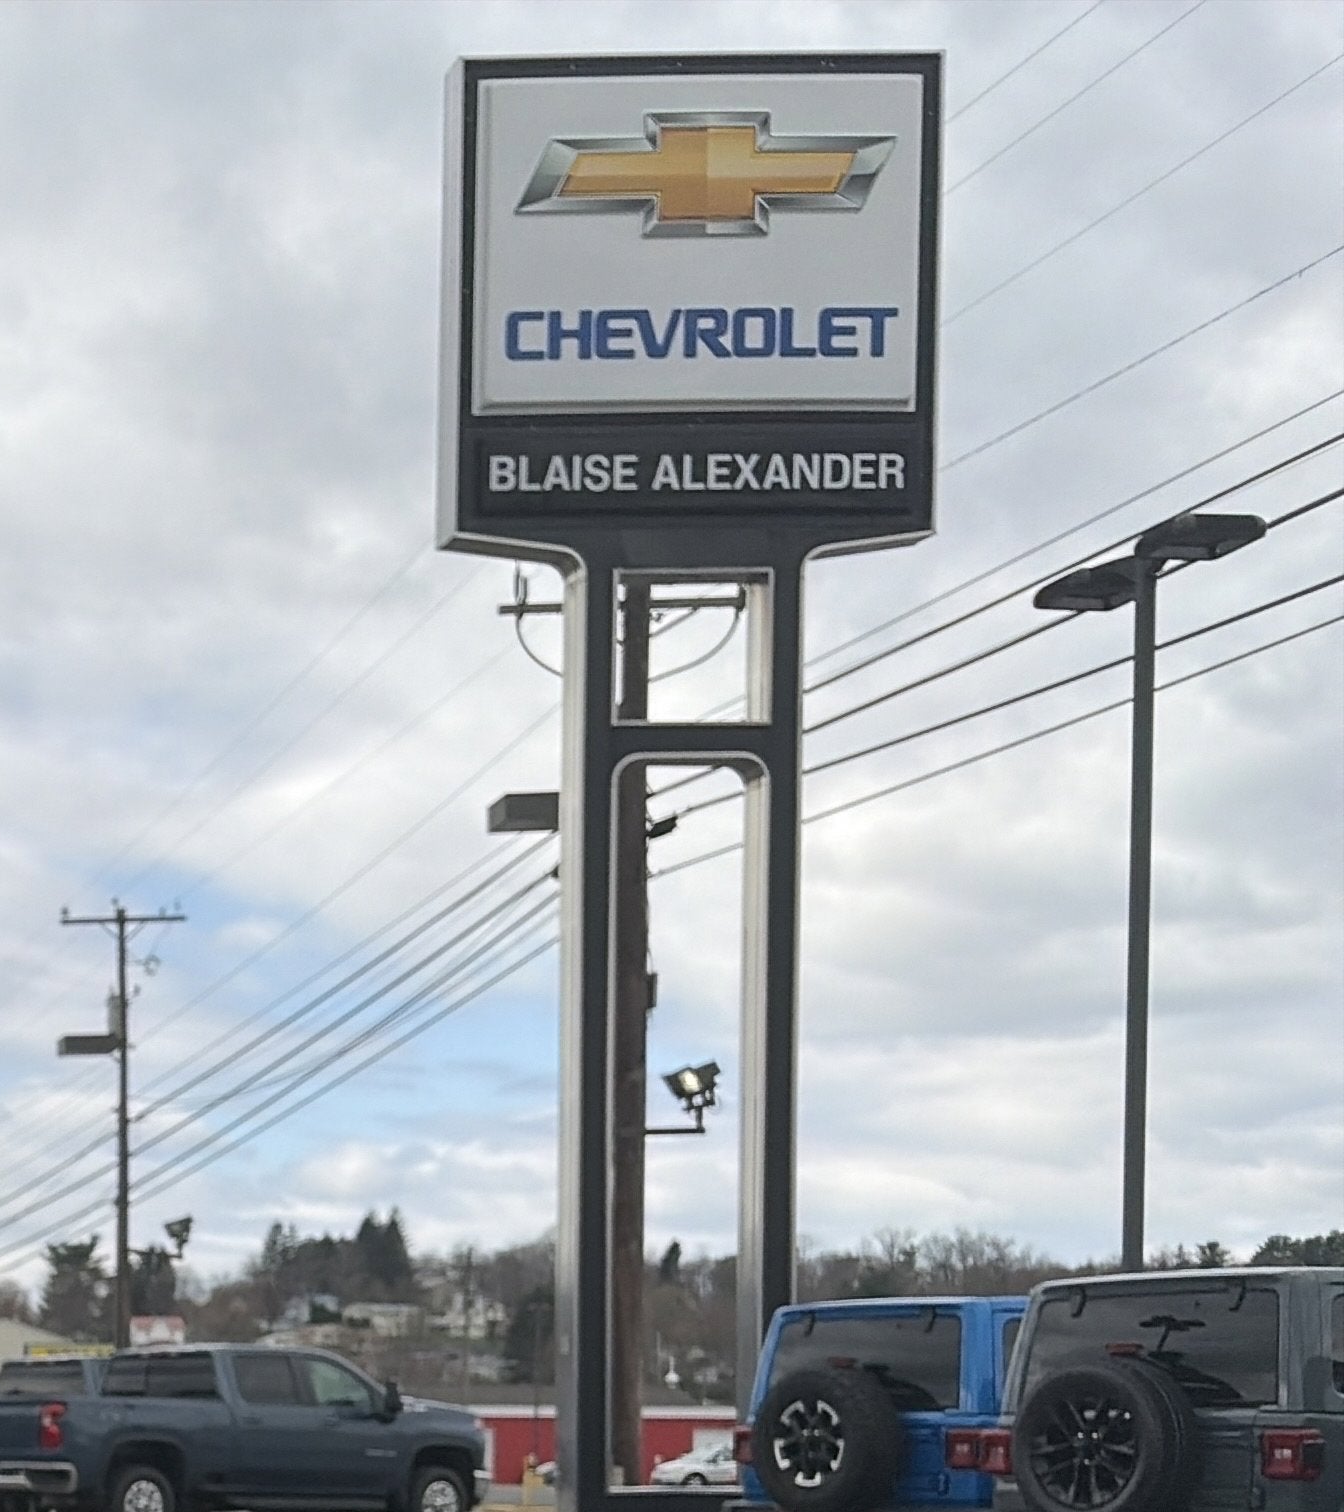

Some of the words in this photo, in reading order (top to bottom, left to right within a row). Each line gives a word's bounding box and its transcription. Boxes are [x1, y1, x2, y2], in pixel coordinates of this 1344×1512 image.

[504, 306, 899, 361] CHEVROLET
[487, 454, 640, 492] BLAISE
[651, 452, 906, 490] ALEXANDER
